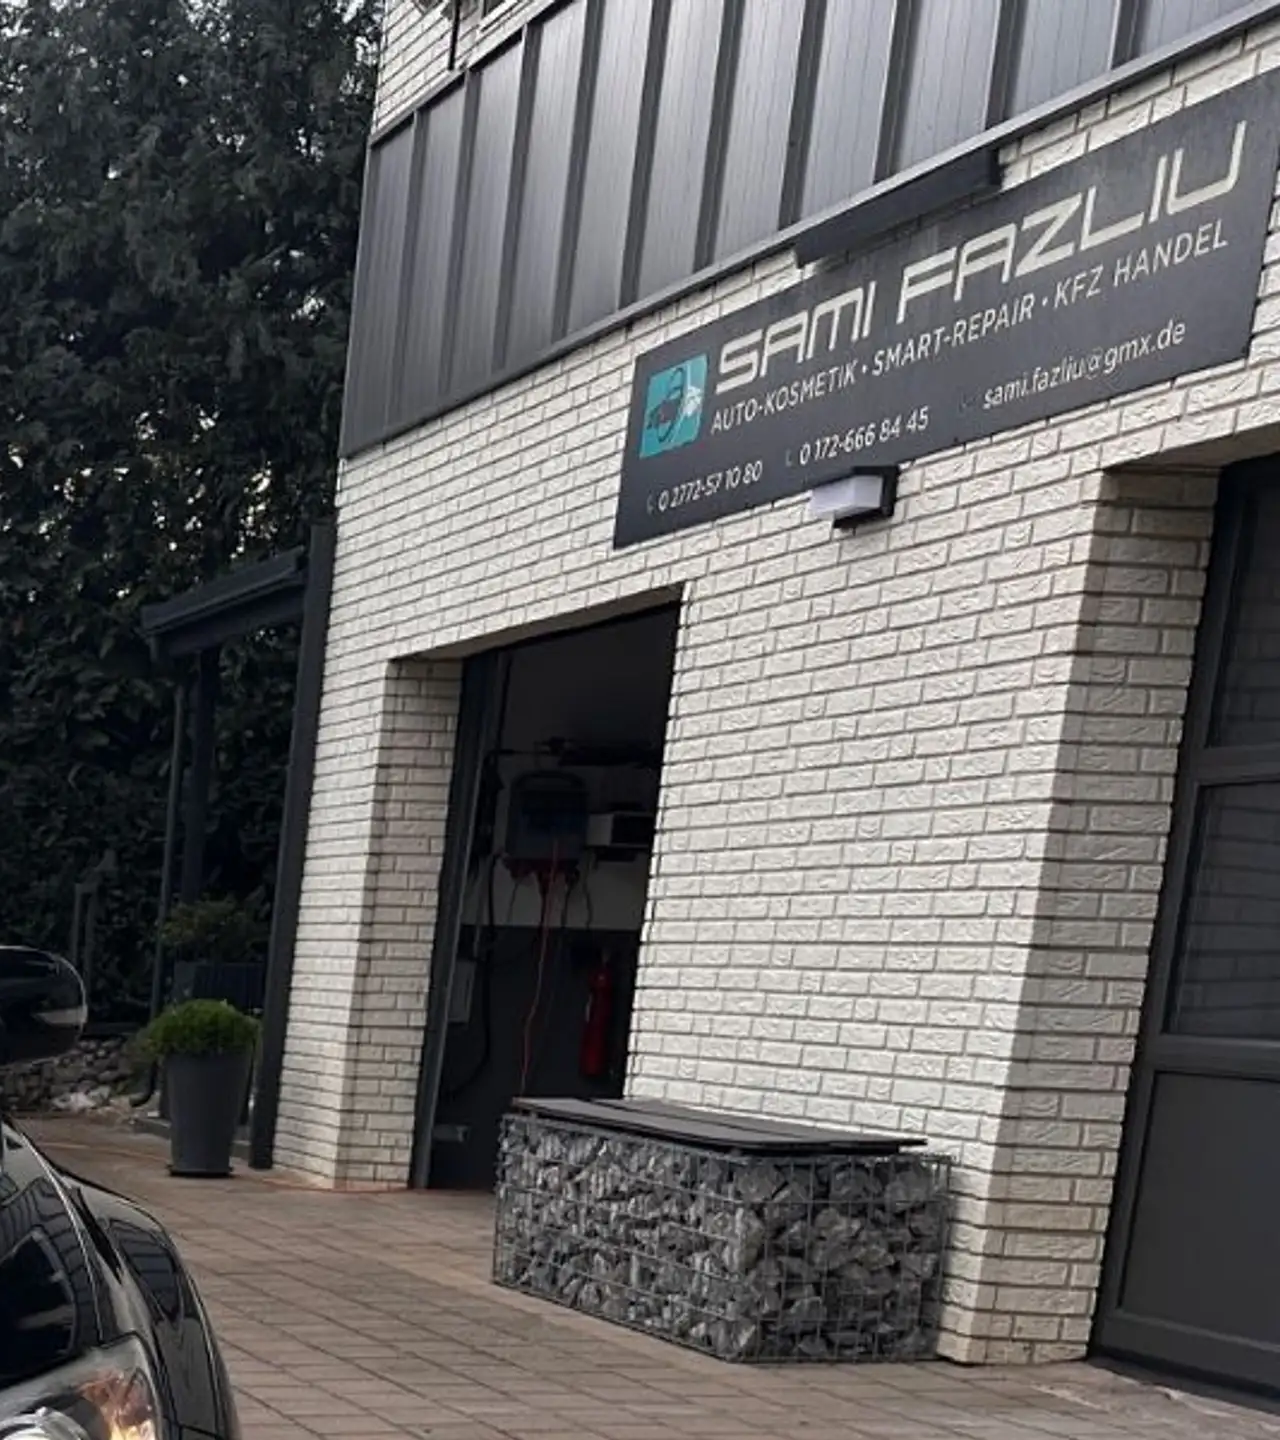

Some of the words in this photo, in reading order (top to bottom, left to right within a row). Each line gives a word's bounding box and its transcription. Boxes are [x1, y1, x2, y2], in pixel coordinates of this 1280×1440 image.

[710, 359, 858, 434] AUTO-KOSMETIK
[871, 292, 1035, 377] SMART-REPAIR
[1053, 264, 1104, 310] KFZ
[1113, 219, 1229, 288] HANDEL
[715, 281, 876, 395] SAMI
[896, 120, 1247, 325] FAZLIU
[906, 405, 930, 432] 45
[983, 319, 1186, 409] sami.fazliu@gmx.de
